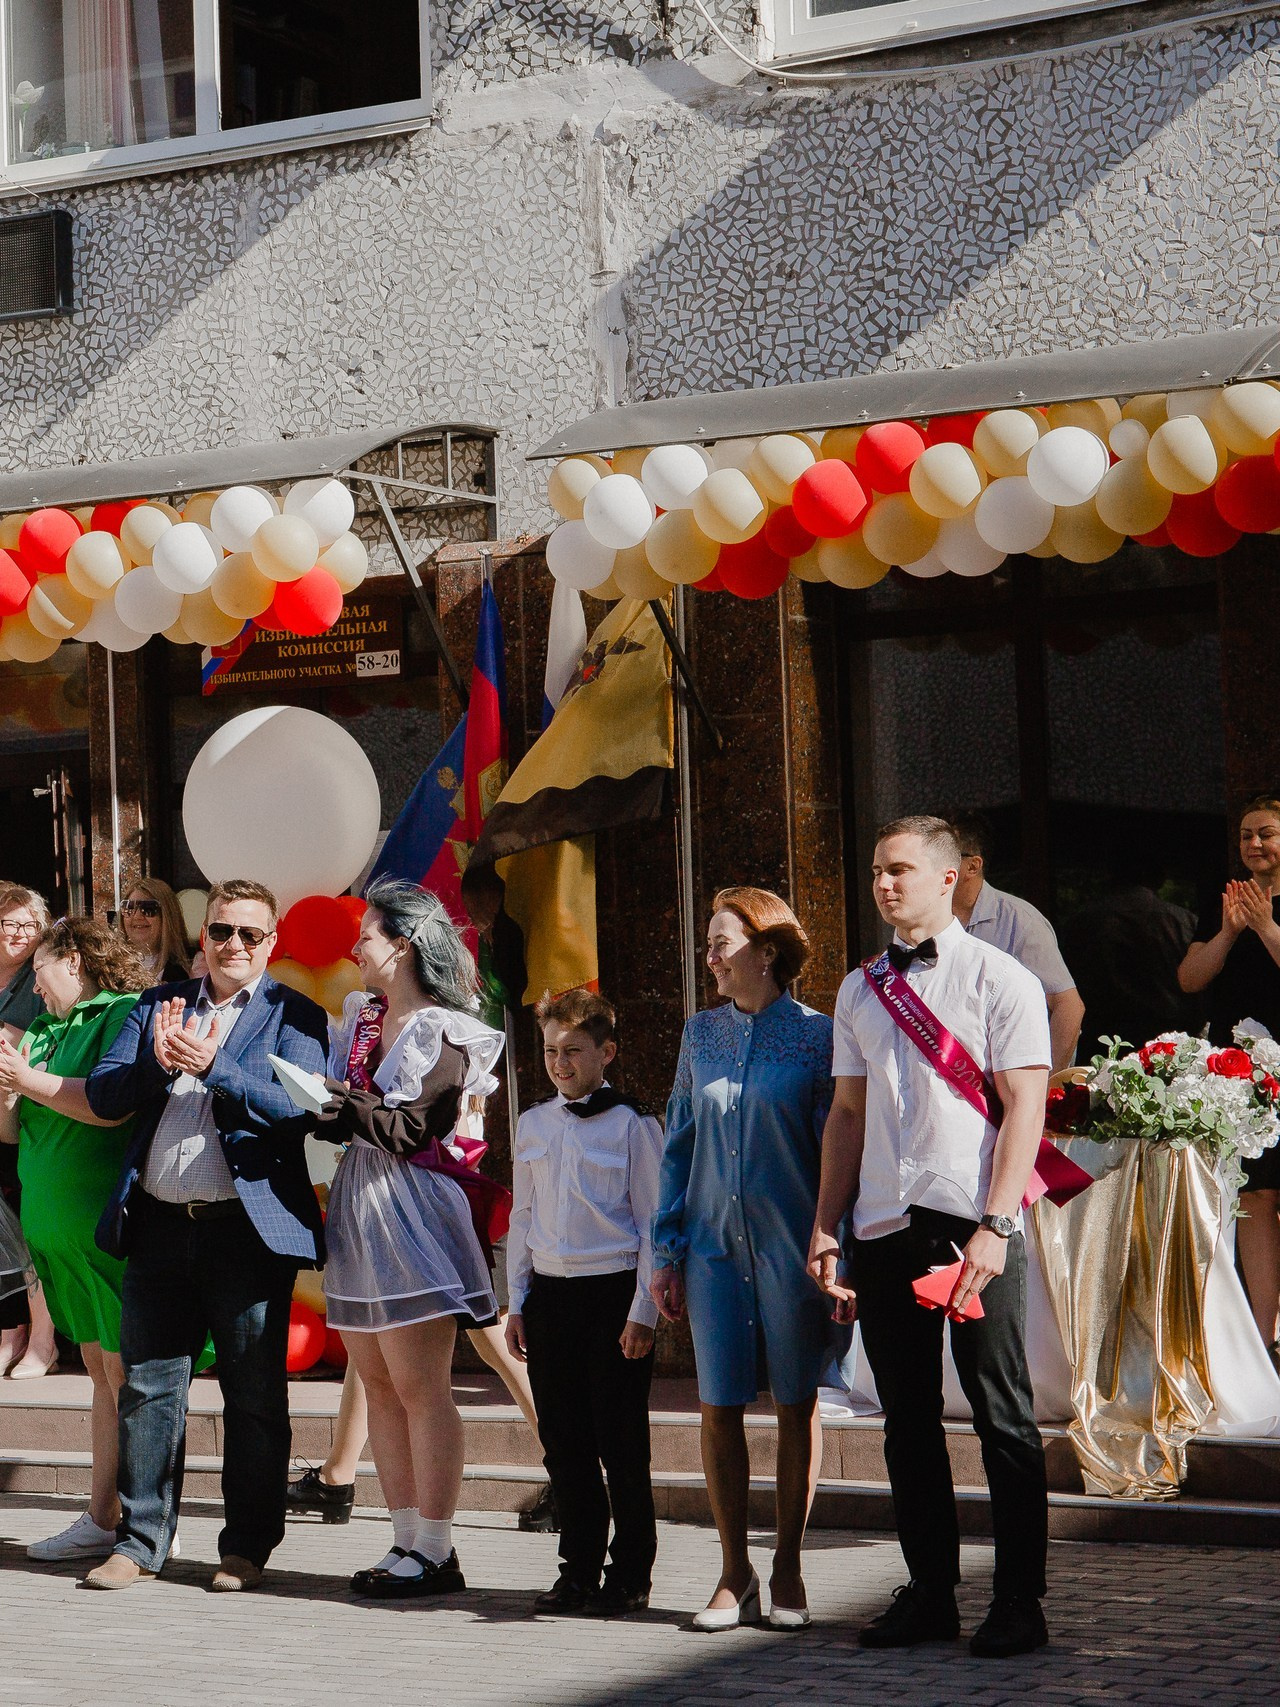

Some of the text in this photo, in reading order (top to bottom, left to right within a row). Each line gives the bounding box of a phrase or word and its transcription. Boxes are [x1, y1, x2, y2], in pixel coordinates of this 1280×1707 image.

[277, 638, 365, 658] КОМИССИЯ
[209, 667, 296, 685] ИЗБИРАТЕЛЬНОГО
[298, 664, 342, 678] УЧАСТКА
